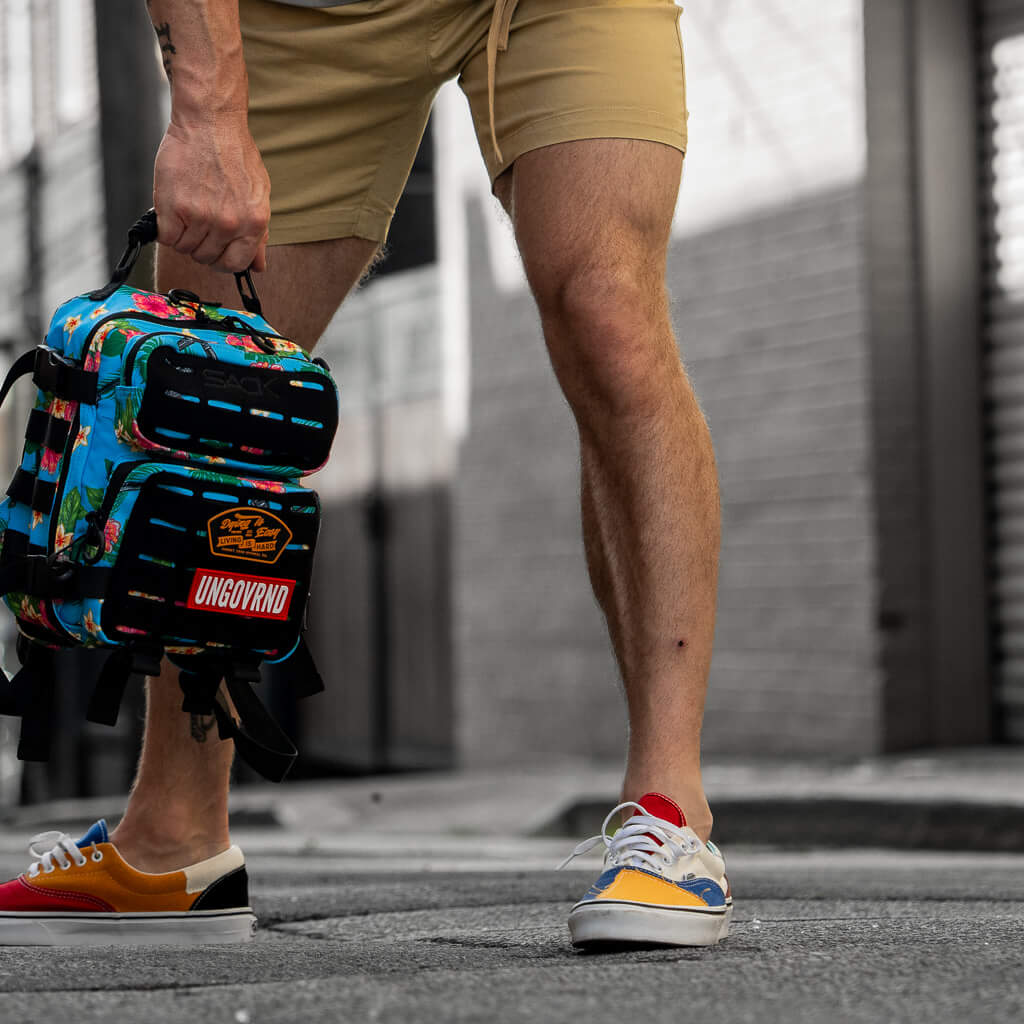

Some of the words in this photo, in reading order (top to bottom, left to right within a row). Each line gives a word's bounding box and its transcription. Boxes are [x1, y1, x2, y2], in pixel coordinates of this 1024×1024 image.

[219, 518, 252, 532] Dying
[254, 527, 281, 540] Easy
[220, 536, 242, 545] LIVING
[256, 542, 275, 550] HARD
[194, 575, 289, 614] UNGOVRND
